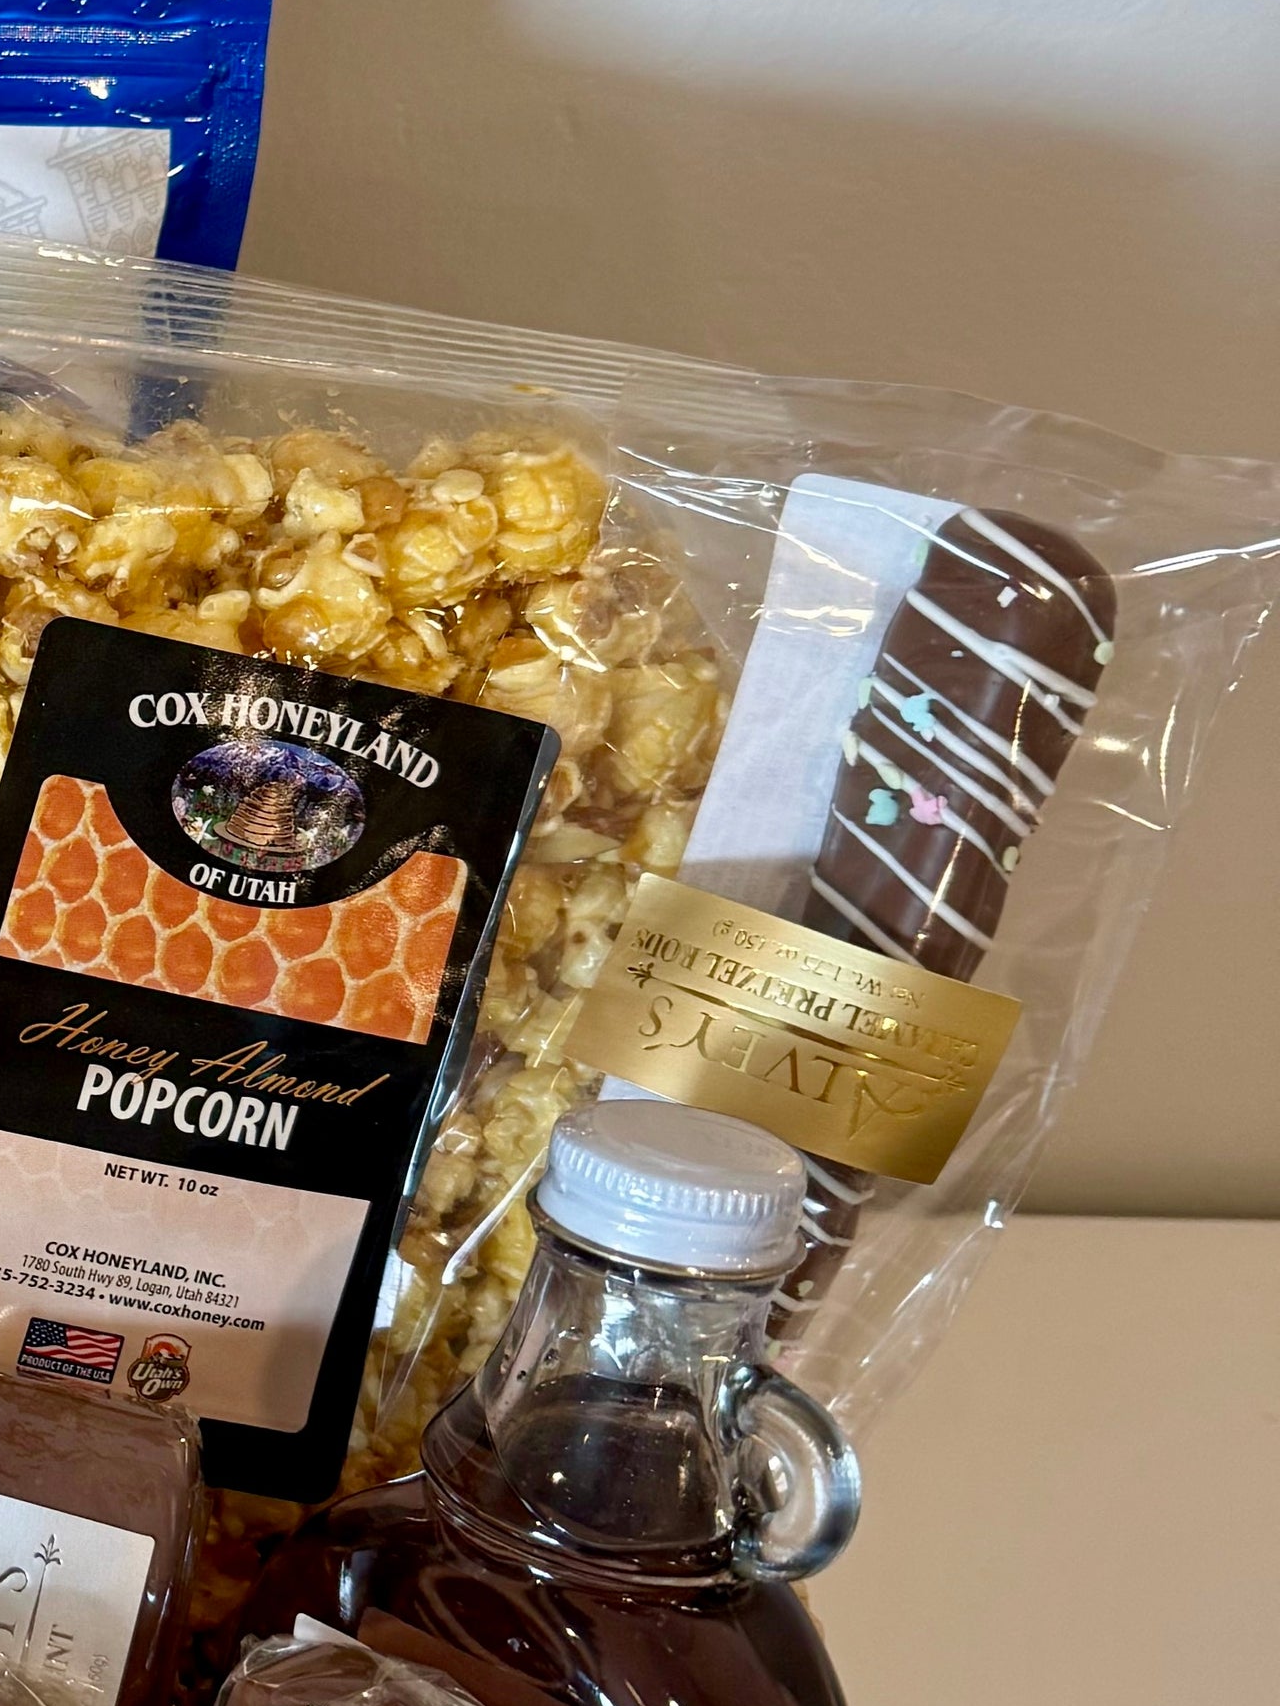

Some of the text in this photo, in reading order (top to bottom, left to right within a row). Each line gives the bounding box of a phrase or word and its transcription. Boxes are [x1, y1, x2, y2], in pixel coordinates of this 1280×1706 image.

[129, 693, 439, 788] COX HONEYLAND
[189, 863, 296, 904] OF UTAH
[630, 928, 979, 1068] CARAMEL PRETZEL RODS
[19, 1003, 390, 1106] Honey Almond
[76, 1064, 299, 1150] POPCORN
[104, 1163, 219, 1196] NET WT. 10 oz
[22, 1255, 239, 1308] 1780 South Hwy 89, Logan, Utah 84321
[45, 1241, 226, 1288] COX HONEYLAND, INC.
[108, 1294, 265, 1331] www.coxhoney.com
[20, 1355, 110, 1382] PRODUCT OF THE USA
[142, 1378, 183, 1395] Own
